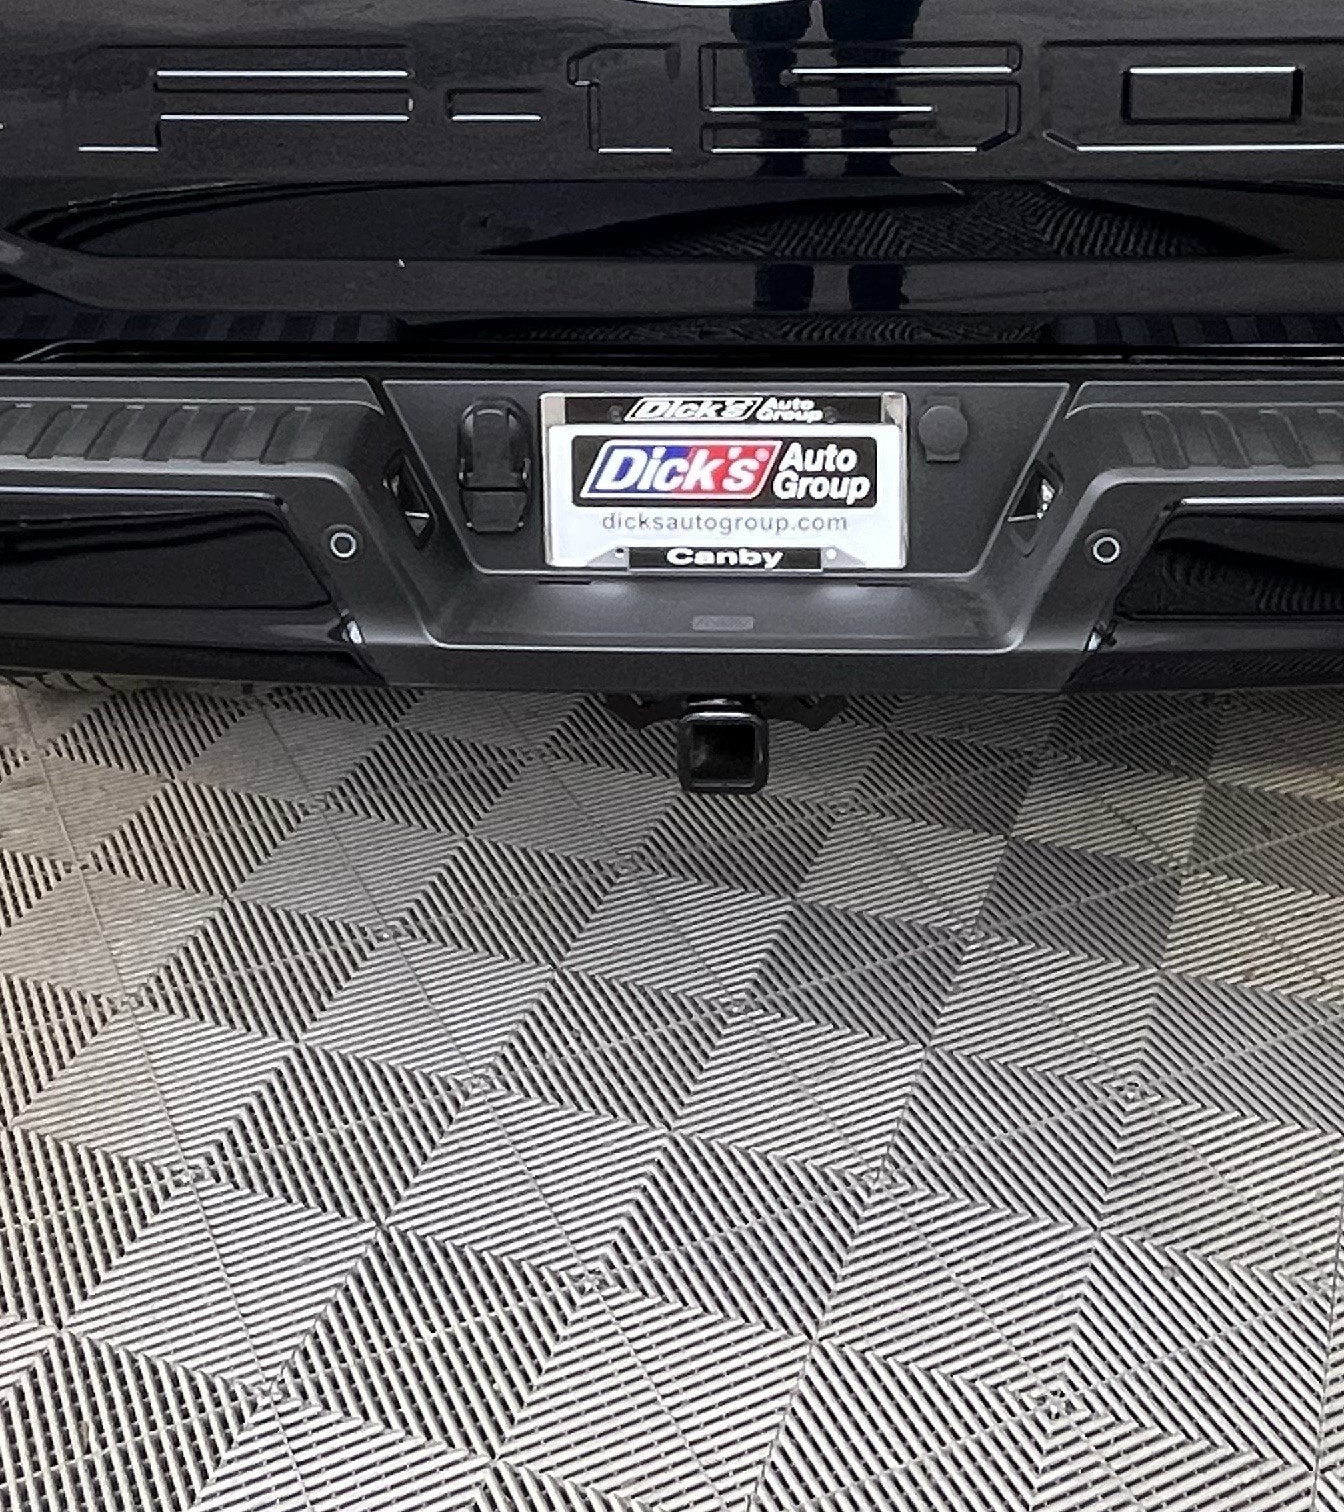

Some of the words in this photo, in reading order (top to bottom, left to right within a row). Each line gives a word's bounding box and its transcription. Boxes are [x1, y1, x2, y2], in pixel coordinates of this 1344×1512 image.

[763, 397, 815, 410] Auto
[757, 408, 823, 423] Group
[777, 443, 857, 472] Auto
[772, 471, 870, 505] Group
[602, 513, 848, 535] dicksautogroup.com
[666, 548, 783, 569] Canby
